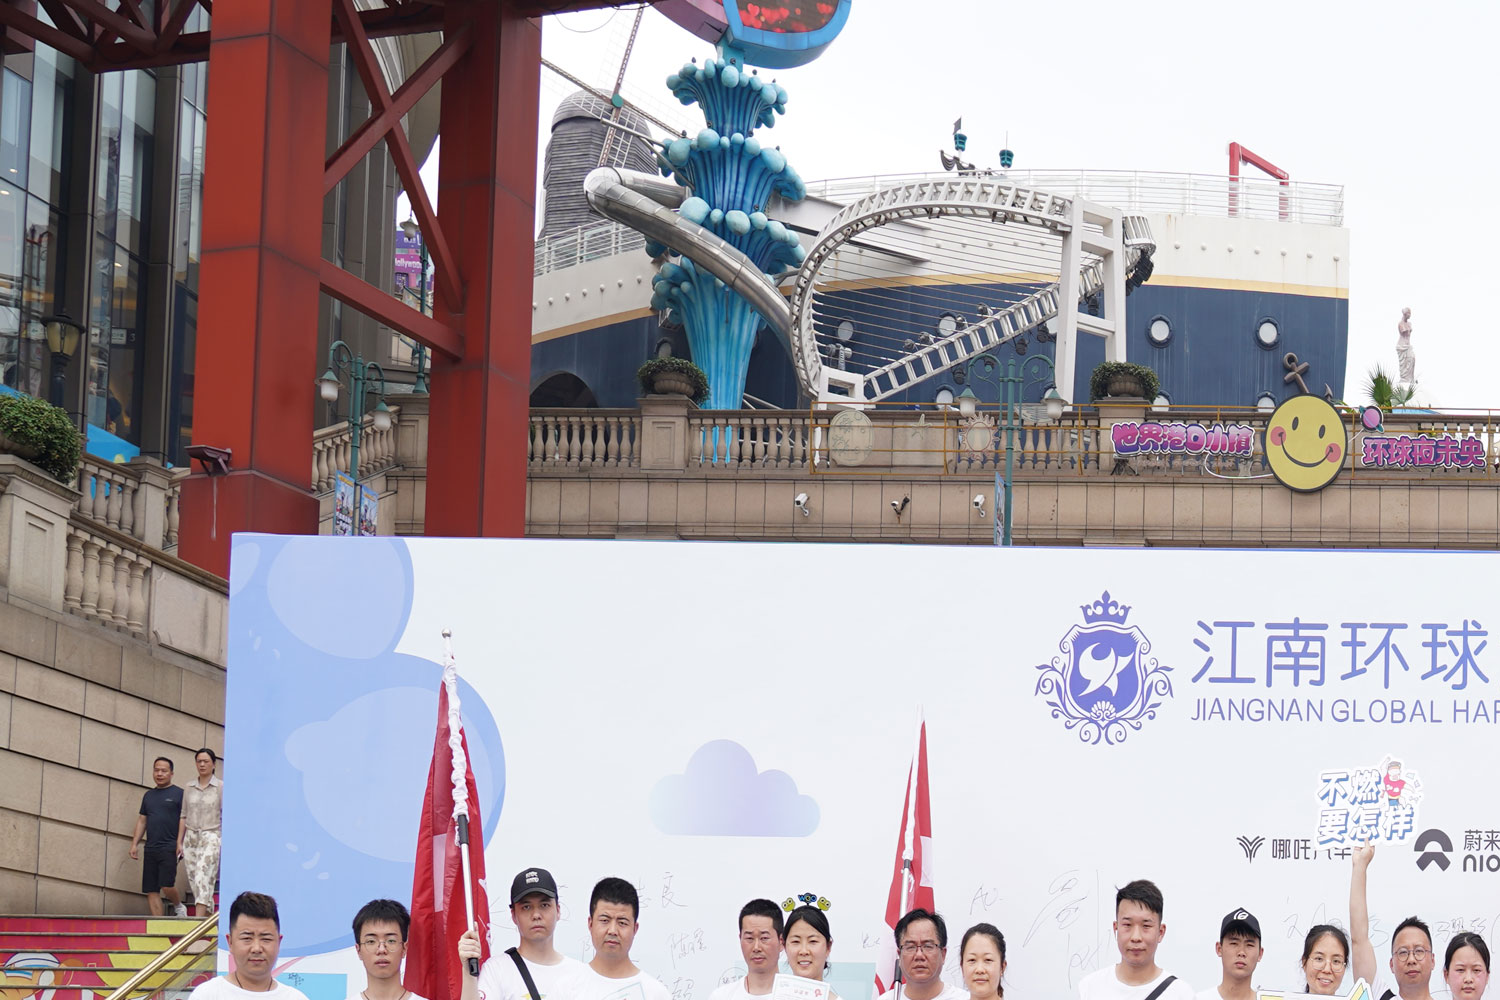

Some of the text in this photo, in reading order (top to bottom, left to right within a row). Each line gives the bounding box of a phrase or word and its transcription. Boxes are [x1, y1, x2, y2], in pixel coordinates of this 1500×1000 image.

[1363, 434, 1486, 467] 环球夜未央
[1190, 697, 1324, 722] JIANGNAN
[1331, 699, 1443, 724] GLOBAL
[1317, 769, 1382, 807] 不燃
[1317, 804, 1415, 846] 要怎样
[1463, 829, 1500, 852] 蔚来
